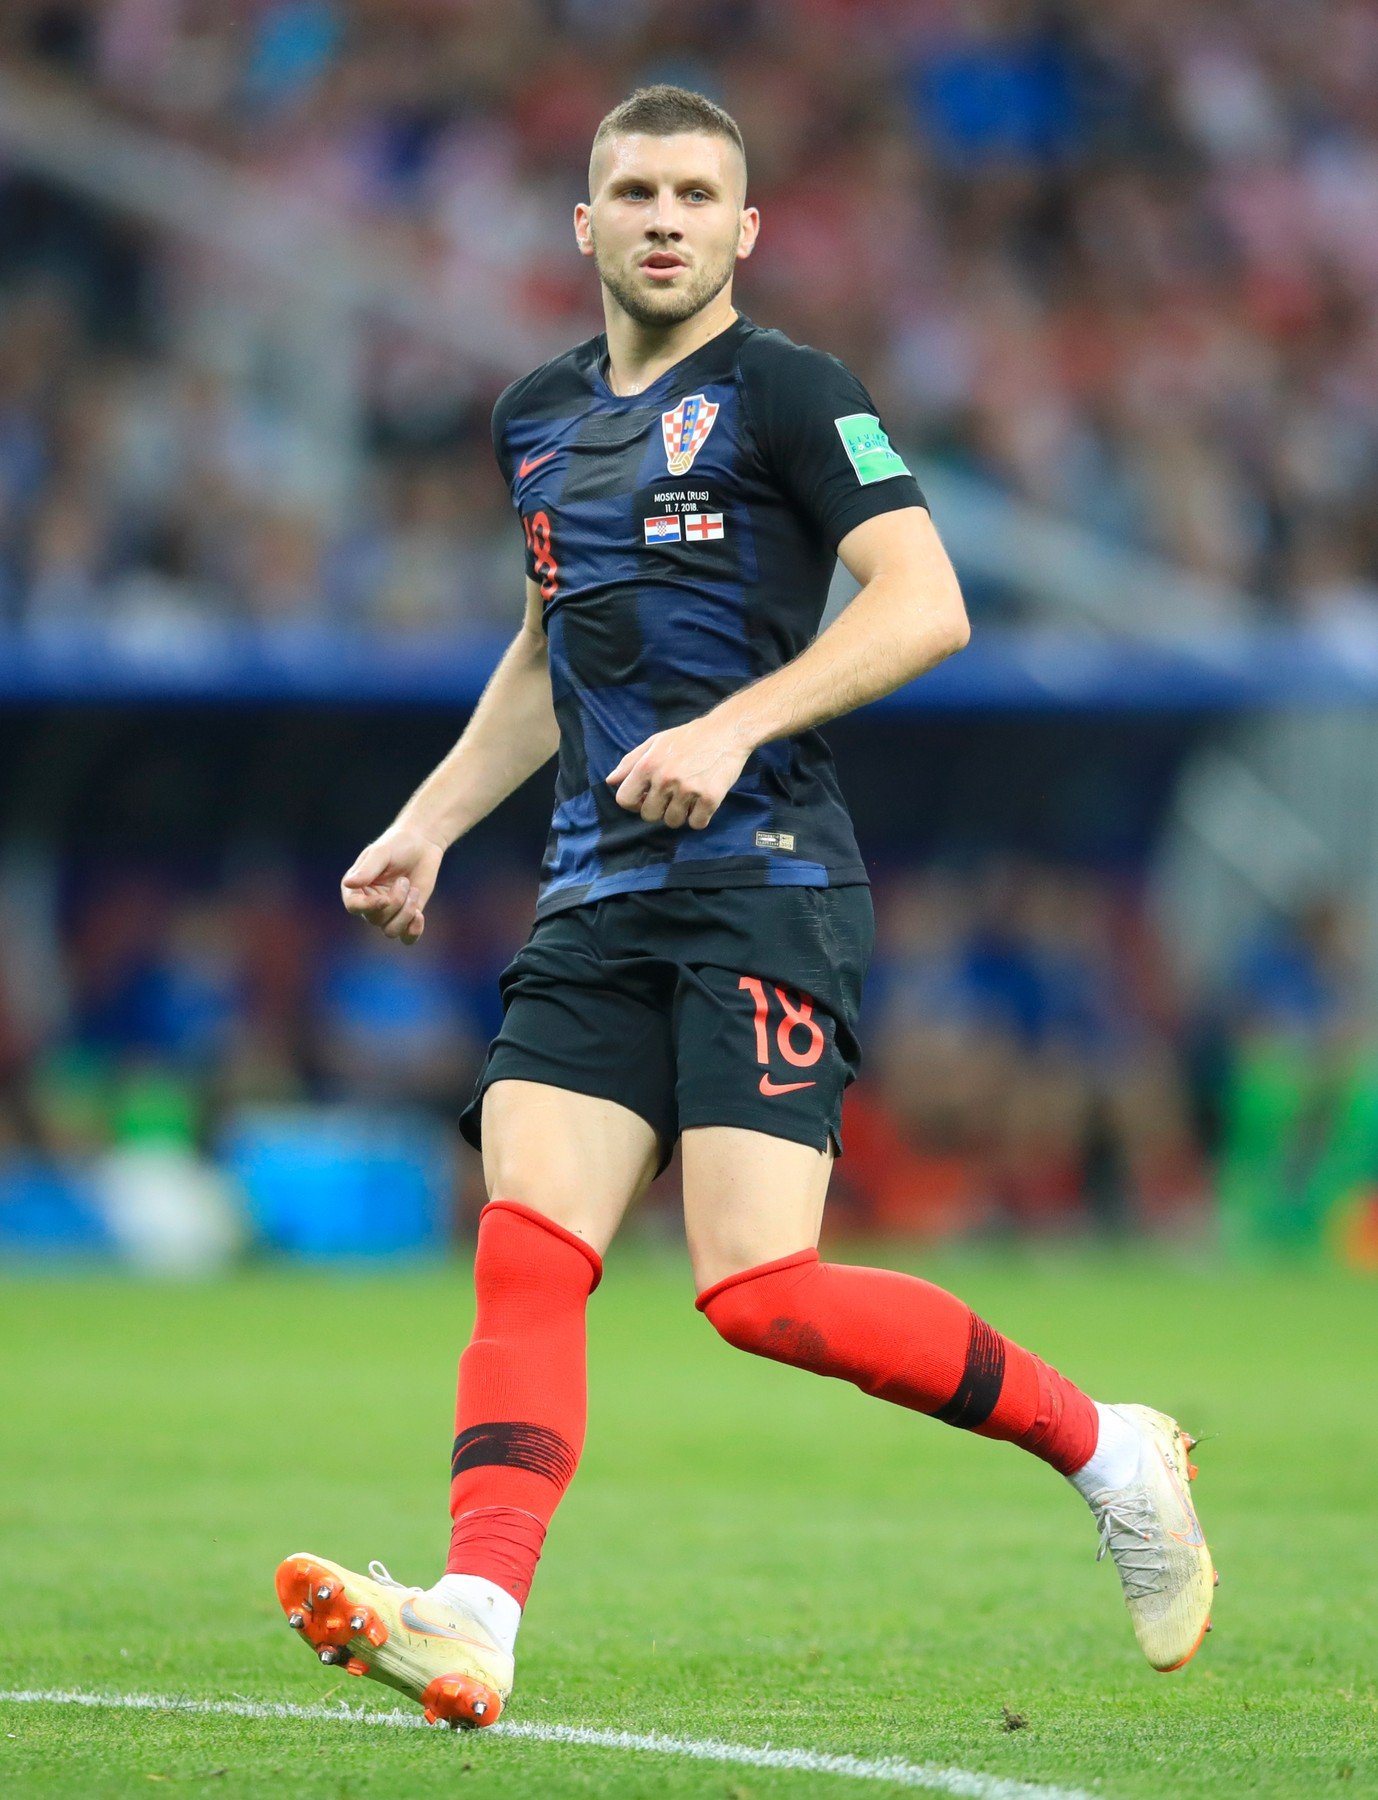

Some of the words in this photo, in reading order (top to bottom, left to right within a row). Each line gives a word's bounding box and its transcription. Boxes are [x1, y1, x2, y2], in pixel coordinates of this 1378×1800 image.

[654, 491, 686, 503] MOSKVA
[687, 490, 709, 501] (RUS)
[738, 976, 824, 1068] 18
